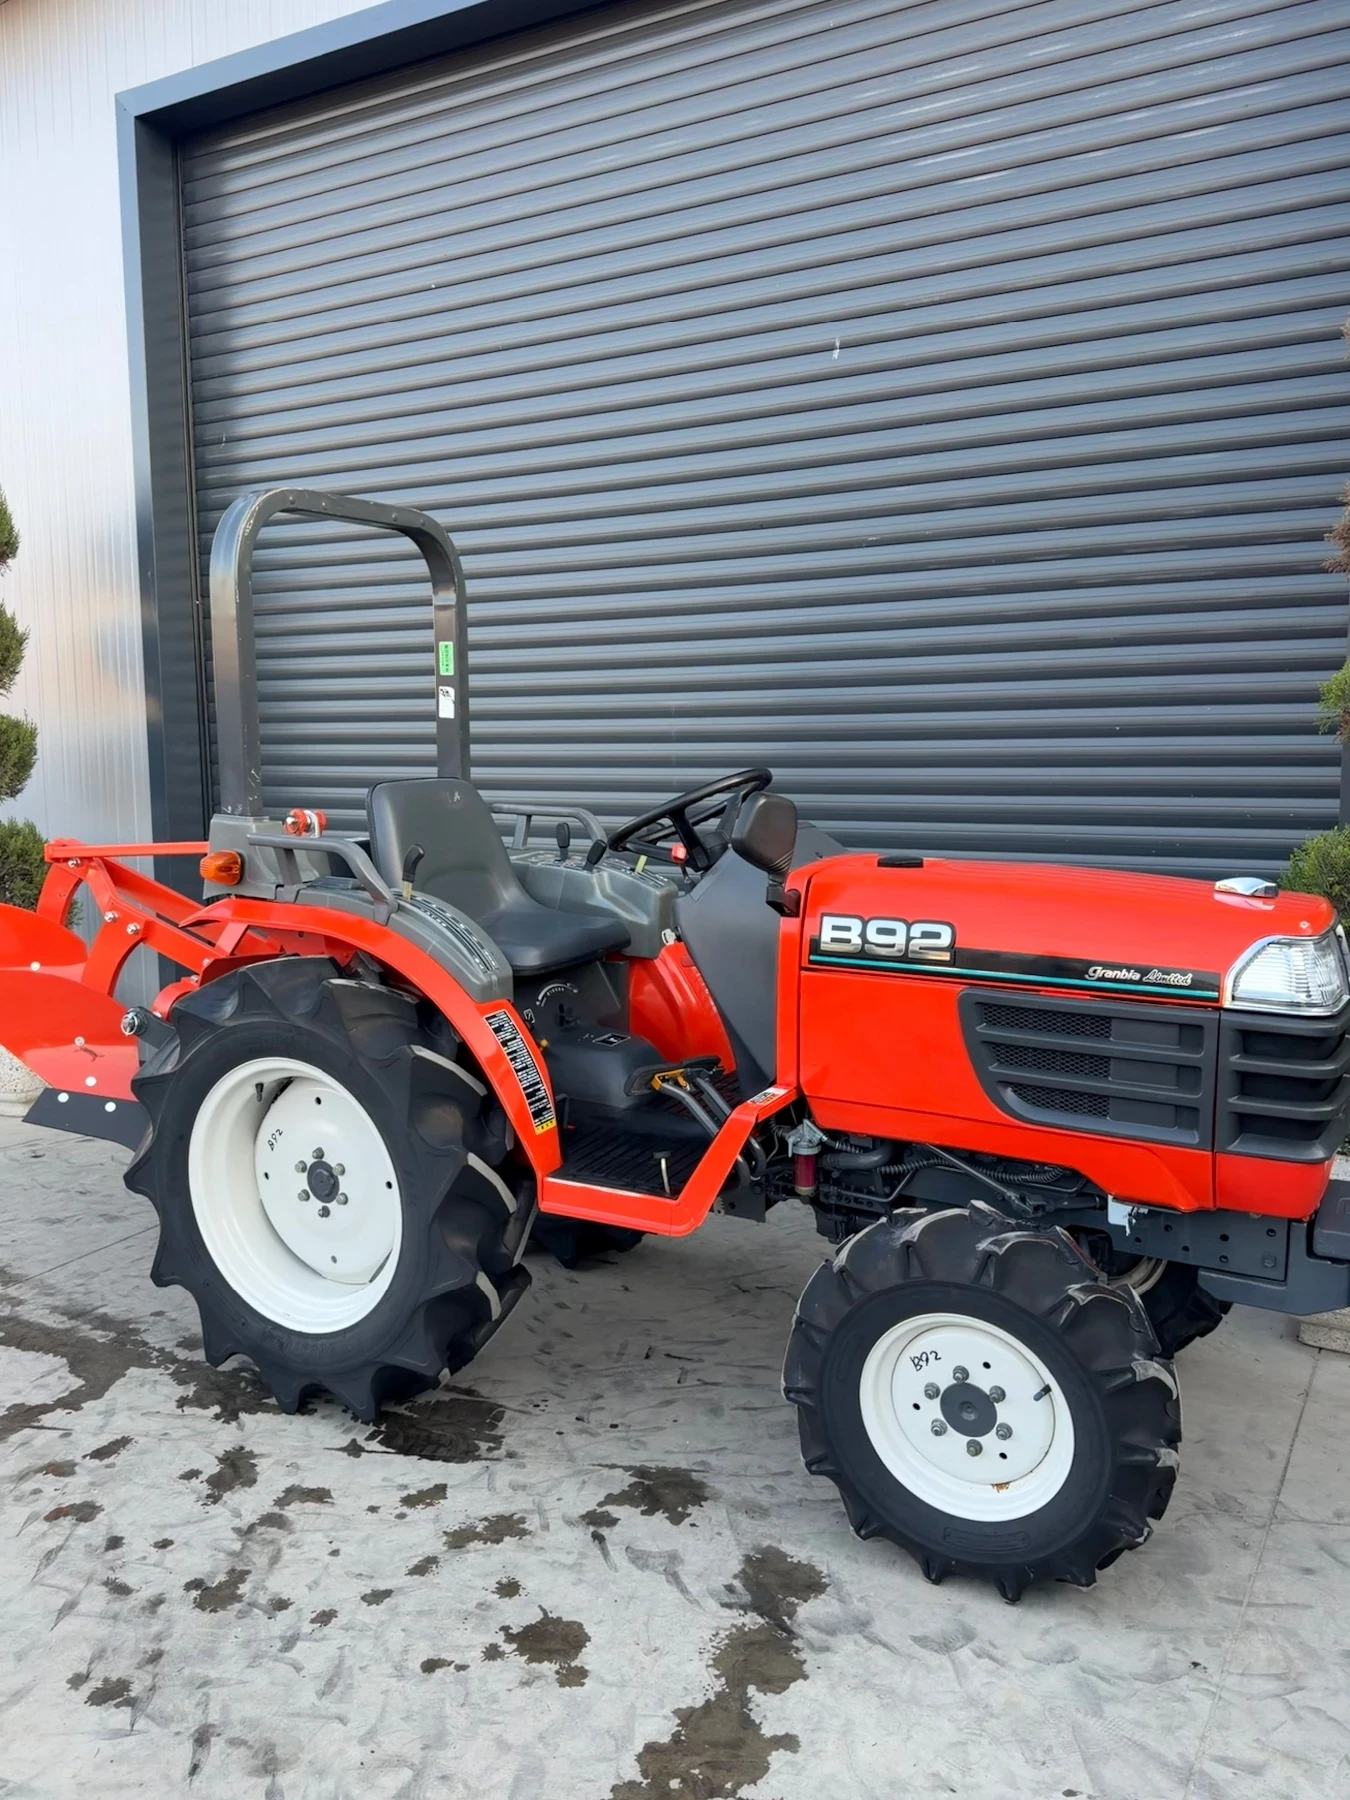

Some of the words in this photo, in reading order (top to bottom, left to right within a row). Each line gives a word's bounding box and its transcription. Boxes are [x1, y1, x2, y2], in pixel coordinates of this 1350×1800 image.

[820, 915, 953, 962] B92
[1142, 968, 1193, 986] Limited
[909, 1350, 942, 1372] B92
